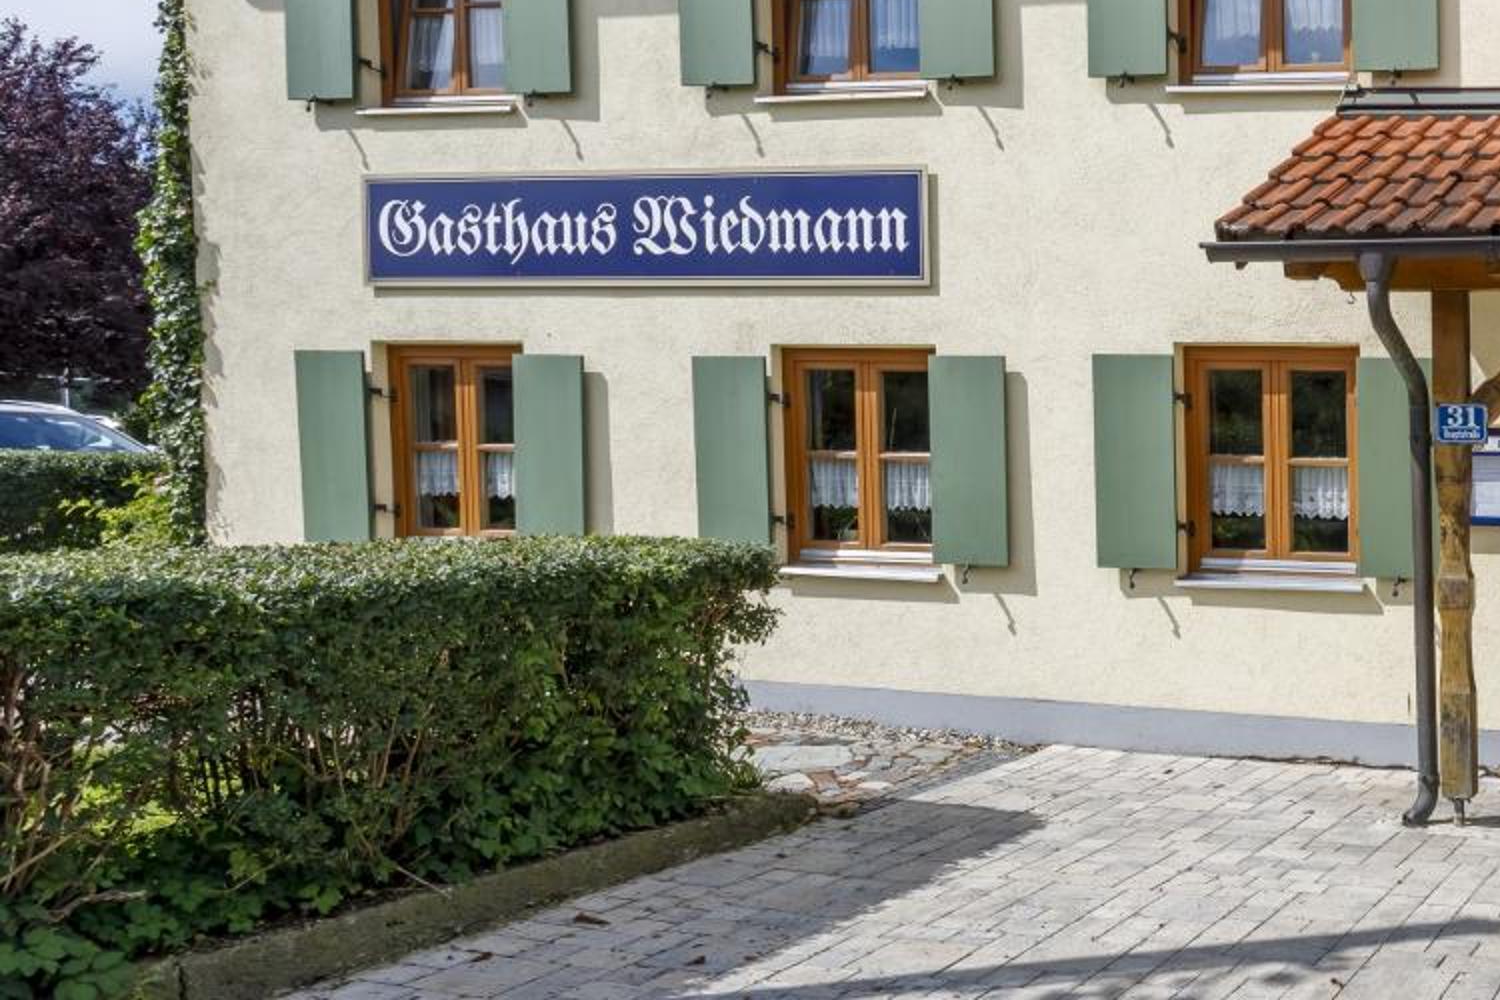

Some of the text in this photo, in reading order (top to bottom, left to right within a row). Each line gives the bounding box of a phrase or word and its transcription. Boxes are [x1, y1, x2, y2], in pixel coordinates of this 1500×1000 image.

[378, 194, 908, 265] Gasthaus Wiedmann
[1447, 406, 1477, 427] 31
